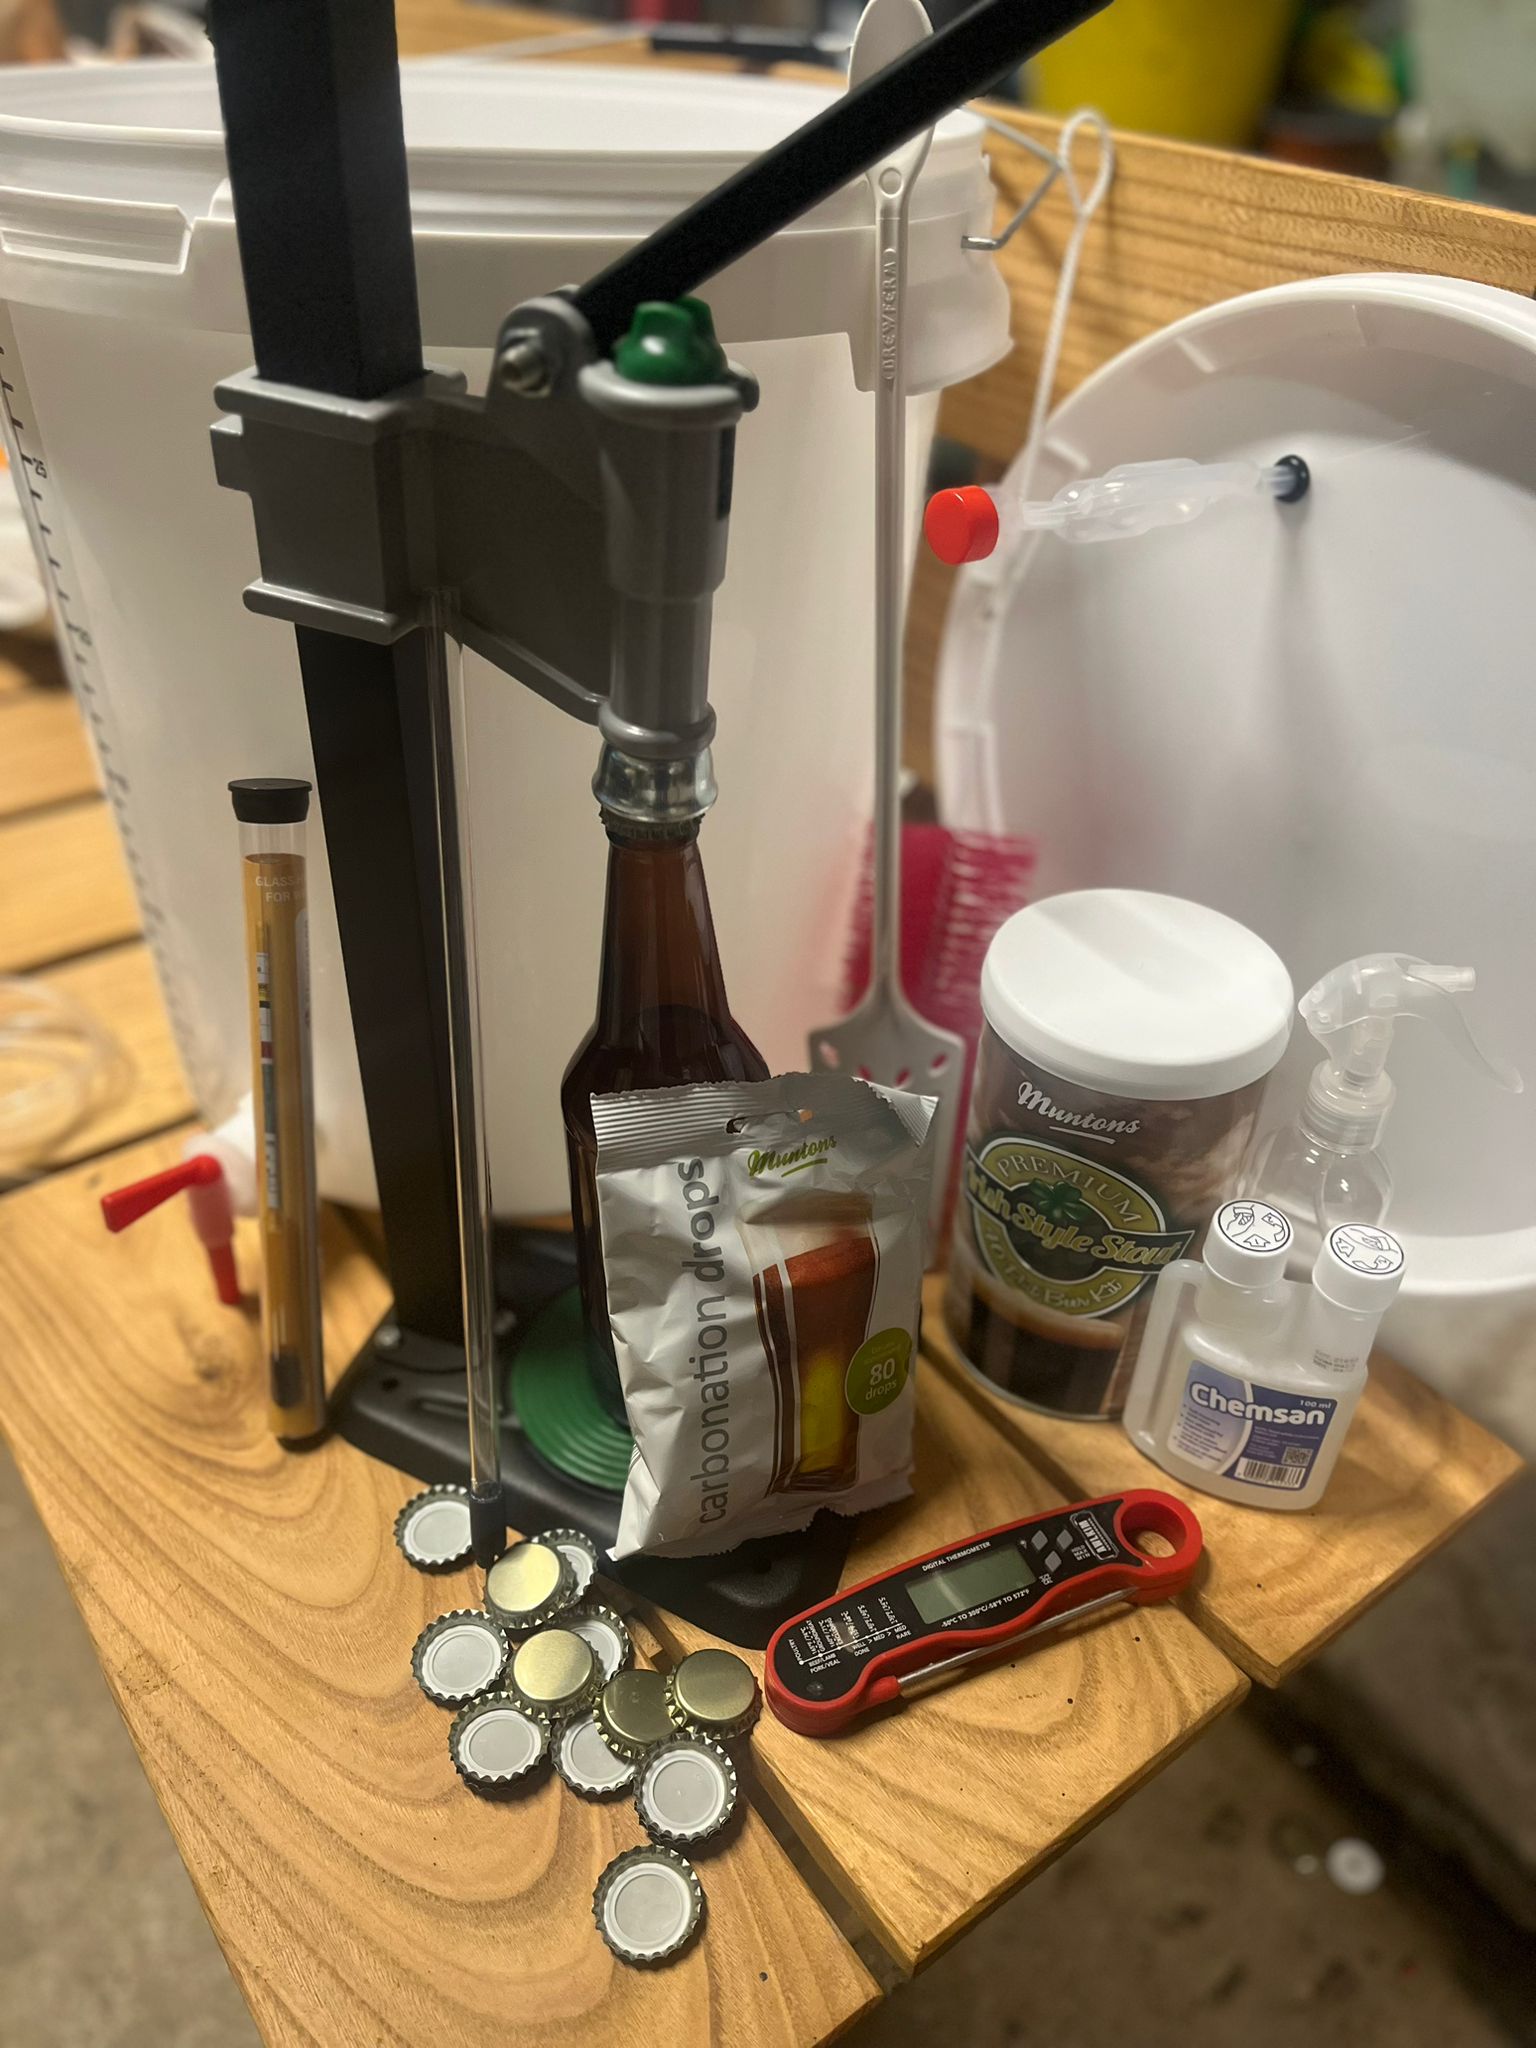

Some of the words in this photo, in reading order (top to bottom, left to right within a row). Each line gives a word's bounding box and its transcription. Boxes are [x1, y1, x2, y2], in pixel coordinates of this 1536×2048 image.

[33, 457, 47, 478] 25
[265, 892, 290, 903] FOR
[1018, 1081, 1140, 1134] Muntons
[748, 1135, 837, 1177] Muntons
[997, 1154, 1143, 1224] PREMIUM
[678, 1158, 725, 1282] drops
[1012, 1203, 1094, 1250] Style
[1090, 1232, 1183, 1265] Stout
[868, 1358, 896, 1387] 80
[865, 1378, 898, 1401] drops
[689, 1295, 730, 1525] carbonation
[1190, 1383, 1326, 1426] Chemsan
[1300, 1400, 1317, 1408] 100
[922, 1559, 946, 1571] DIGITAL
[946, 1541, 991, 1562] THERMOMETER
[958, 1613, 968, 1621] TO
[1003, 1595, 1012, 1604] TO
[873, 1633, 885, 1642] MED
[894, 1625, 907, 1633] MED
[896, 1630, 912, 1640] RARE
[788, 1638, 802, 1661] POULTRY
[852, 1641, 867, 1650] WELL
[854, 1646, 870, 1657] DONE
[810, 1659, 841, 1674] PORK/VEAL
